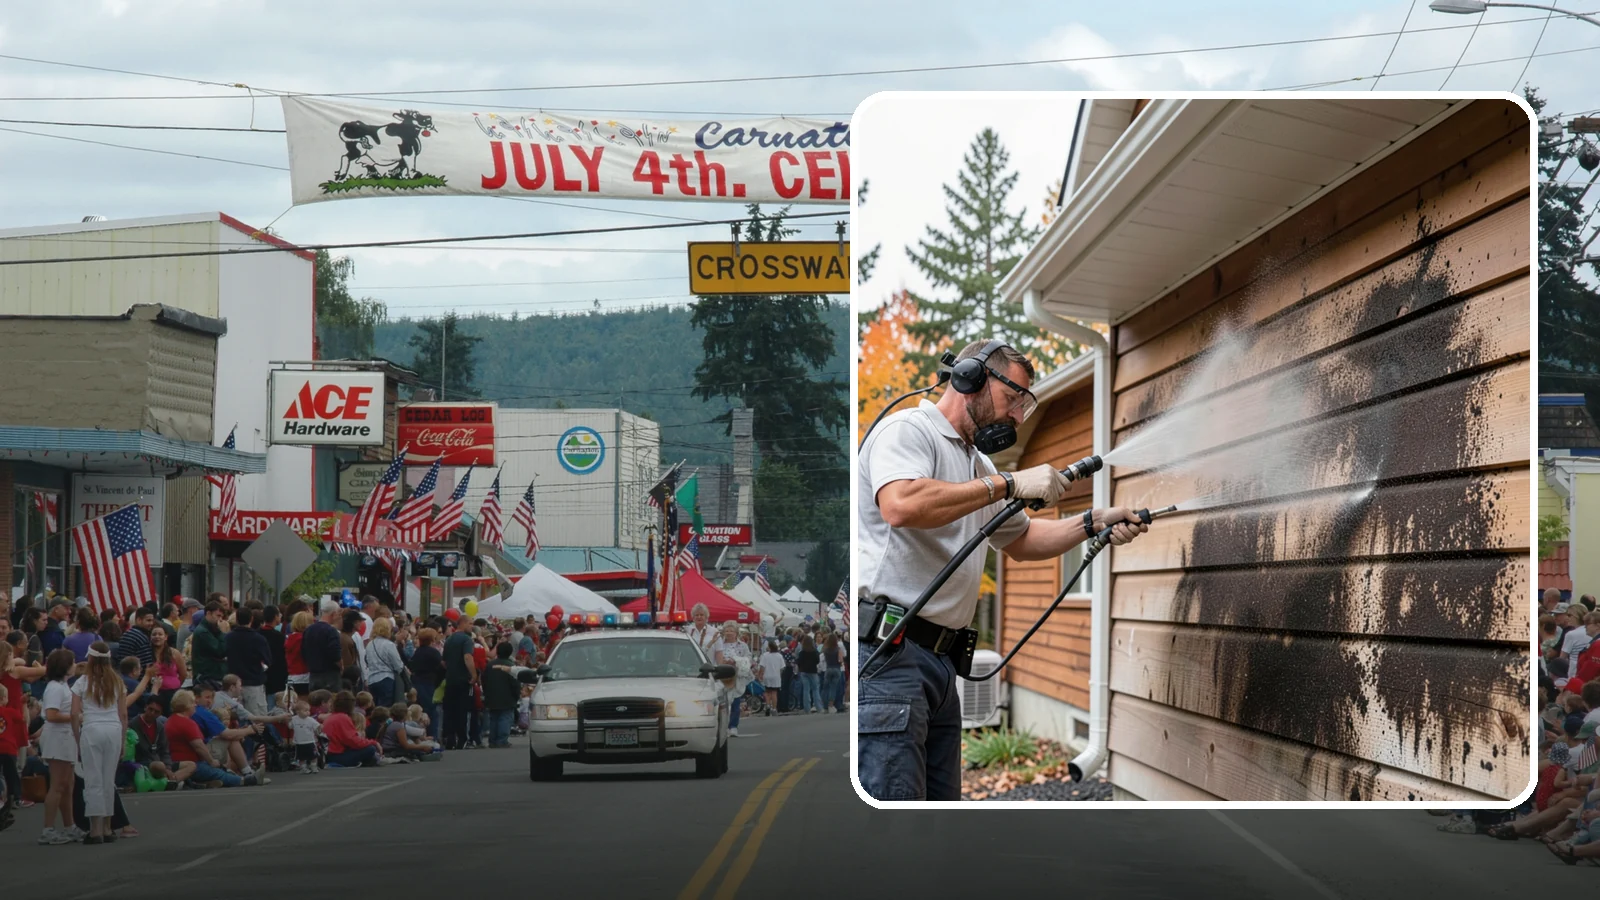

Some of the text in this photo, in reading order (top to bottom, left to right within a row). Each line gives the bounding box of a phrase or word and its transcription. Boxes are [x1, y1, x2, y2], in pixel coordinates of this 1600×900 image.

[695, 121, 850, 150] Carnat
[481, 141, 605, 192] JULY
[632, 150, 746, 197] 4th.
[697, 254, 850, 280] CROSSWA
[283, 380, 373, 420] ACE
[406, 409, 452, 421] CEDAR
[283, 421, 371, 436] Hardware
[353, 467, 385, 482] Simpl
[96, 485, 124, 494] Vincent
[126, 486, 136, 494] de
[138, 486, 155, 495] Paul
[688, 526, 741, 535] CRNATION
[699, 535, 730, 543] GLASS
